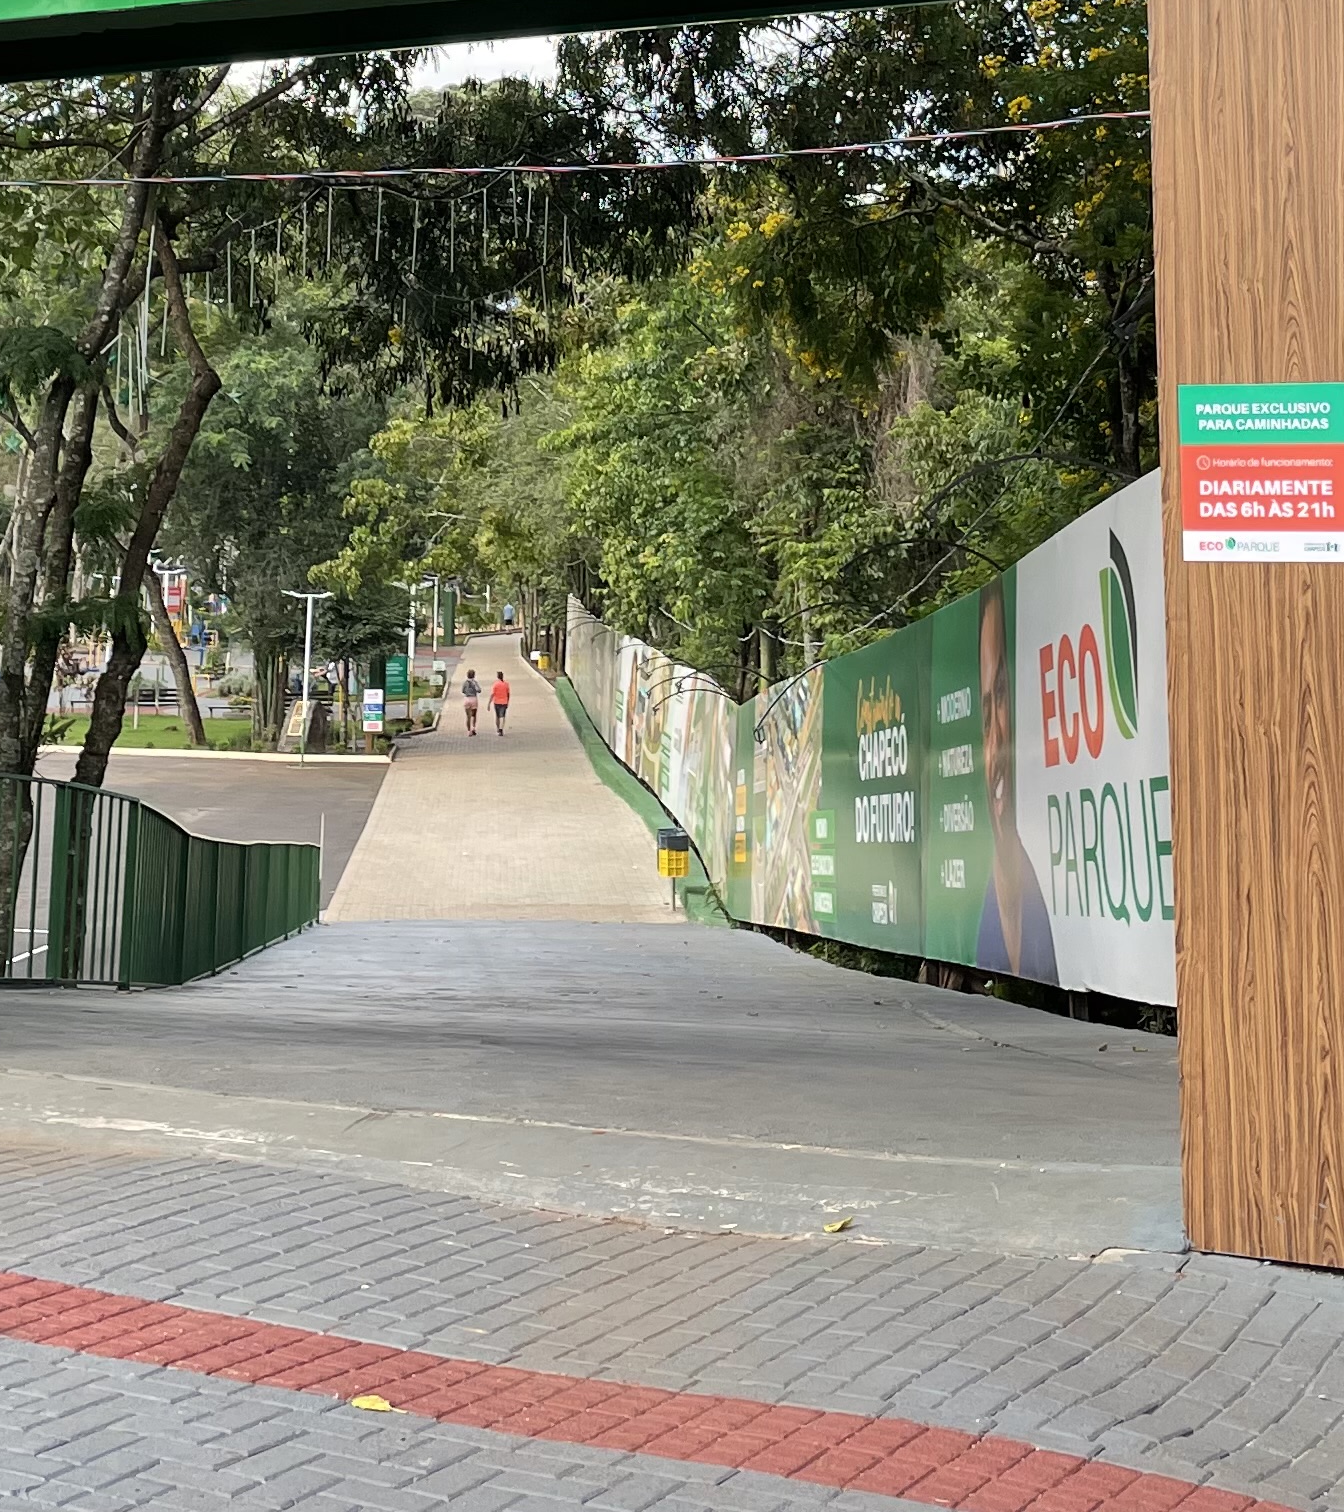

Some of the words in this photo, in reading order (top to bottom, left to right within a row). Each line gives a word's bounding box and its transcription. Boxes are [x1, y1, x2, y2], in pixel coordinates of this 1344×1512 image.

[1196, 403, 1250, 415] PARQUE
[1251, 402, 1331, 414] EXCLUSIVO
[1199, 419, 1234, 430] PARA
[1235, 418, 1330, 430] CAMINHADAS
[1247, 457, 1260, 467] de
[1199, 480, 1333, 496] DIARIAMENTE
[1199, 502, 1238, 518] DAS
[1240, 502, 1265, 518] 6h
[1268, 499, 1294, 518] ÀS
[1297, 501, 1335, 518] 21h
[1199, 541, 1224, 551] ECO
[1237, 541, 1280, 553] PARQUE
[1039, 623, 1104, 768] ECO
[858, 712, 908, 781] CHAPECÓ
[855, 796, 870, 844] DO
[870, 790, 915, 844] FUTURO!
[1047, 775, 1175, 928] PARQUE
